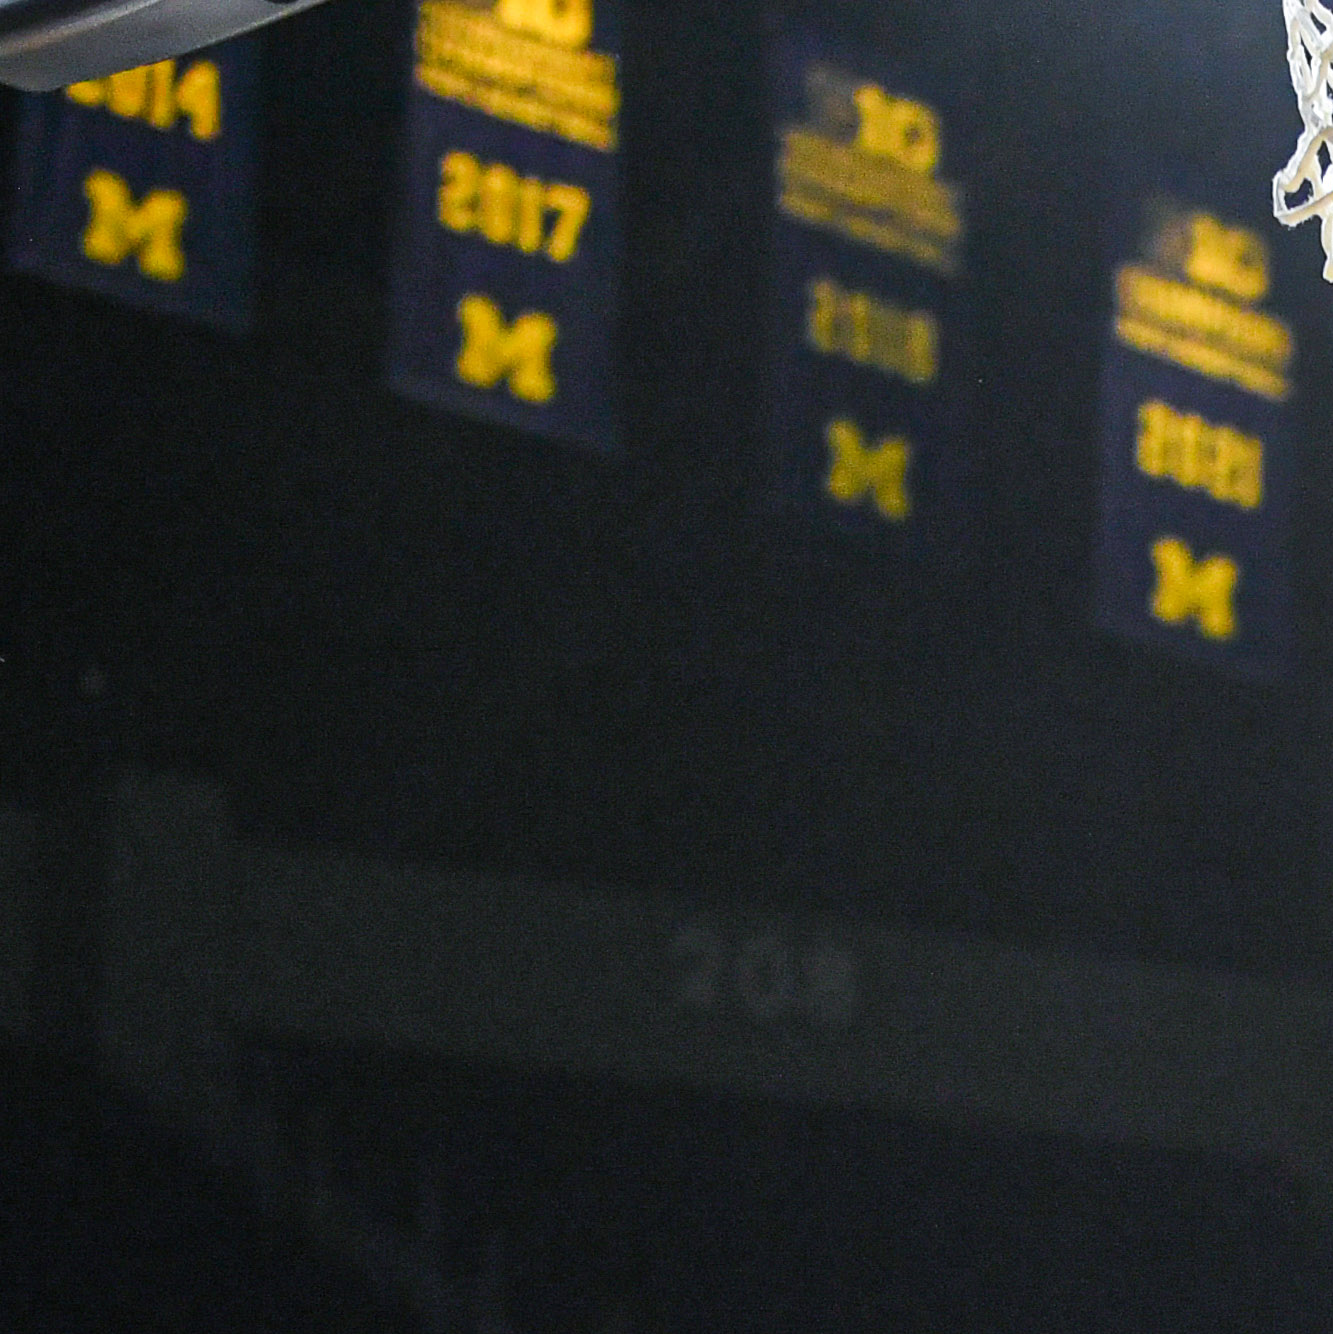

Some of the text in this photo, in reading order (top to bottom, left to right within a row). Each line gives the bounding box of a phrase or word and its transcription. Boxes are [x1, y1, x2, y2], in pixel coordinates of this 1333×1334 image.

[83, 170, 187, 280] M
[438, 150, 590, 262] 2017
[456, 294, 558, 403] M
[826, 418, 909, 520] M
[1151, 538, 1239, 639] M
